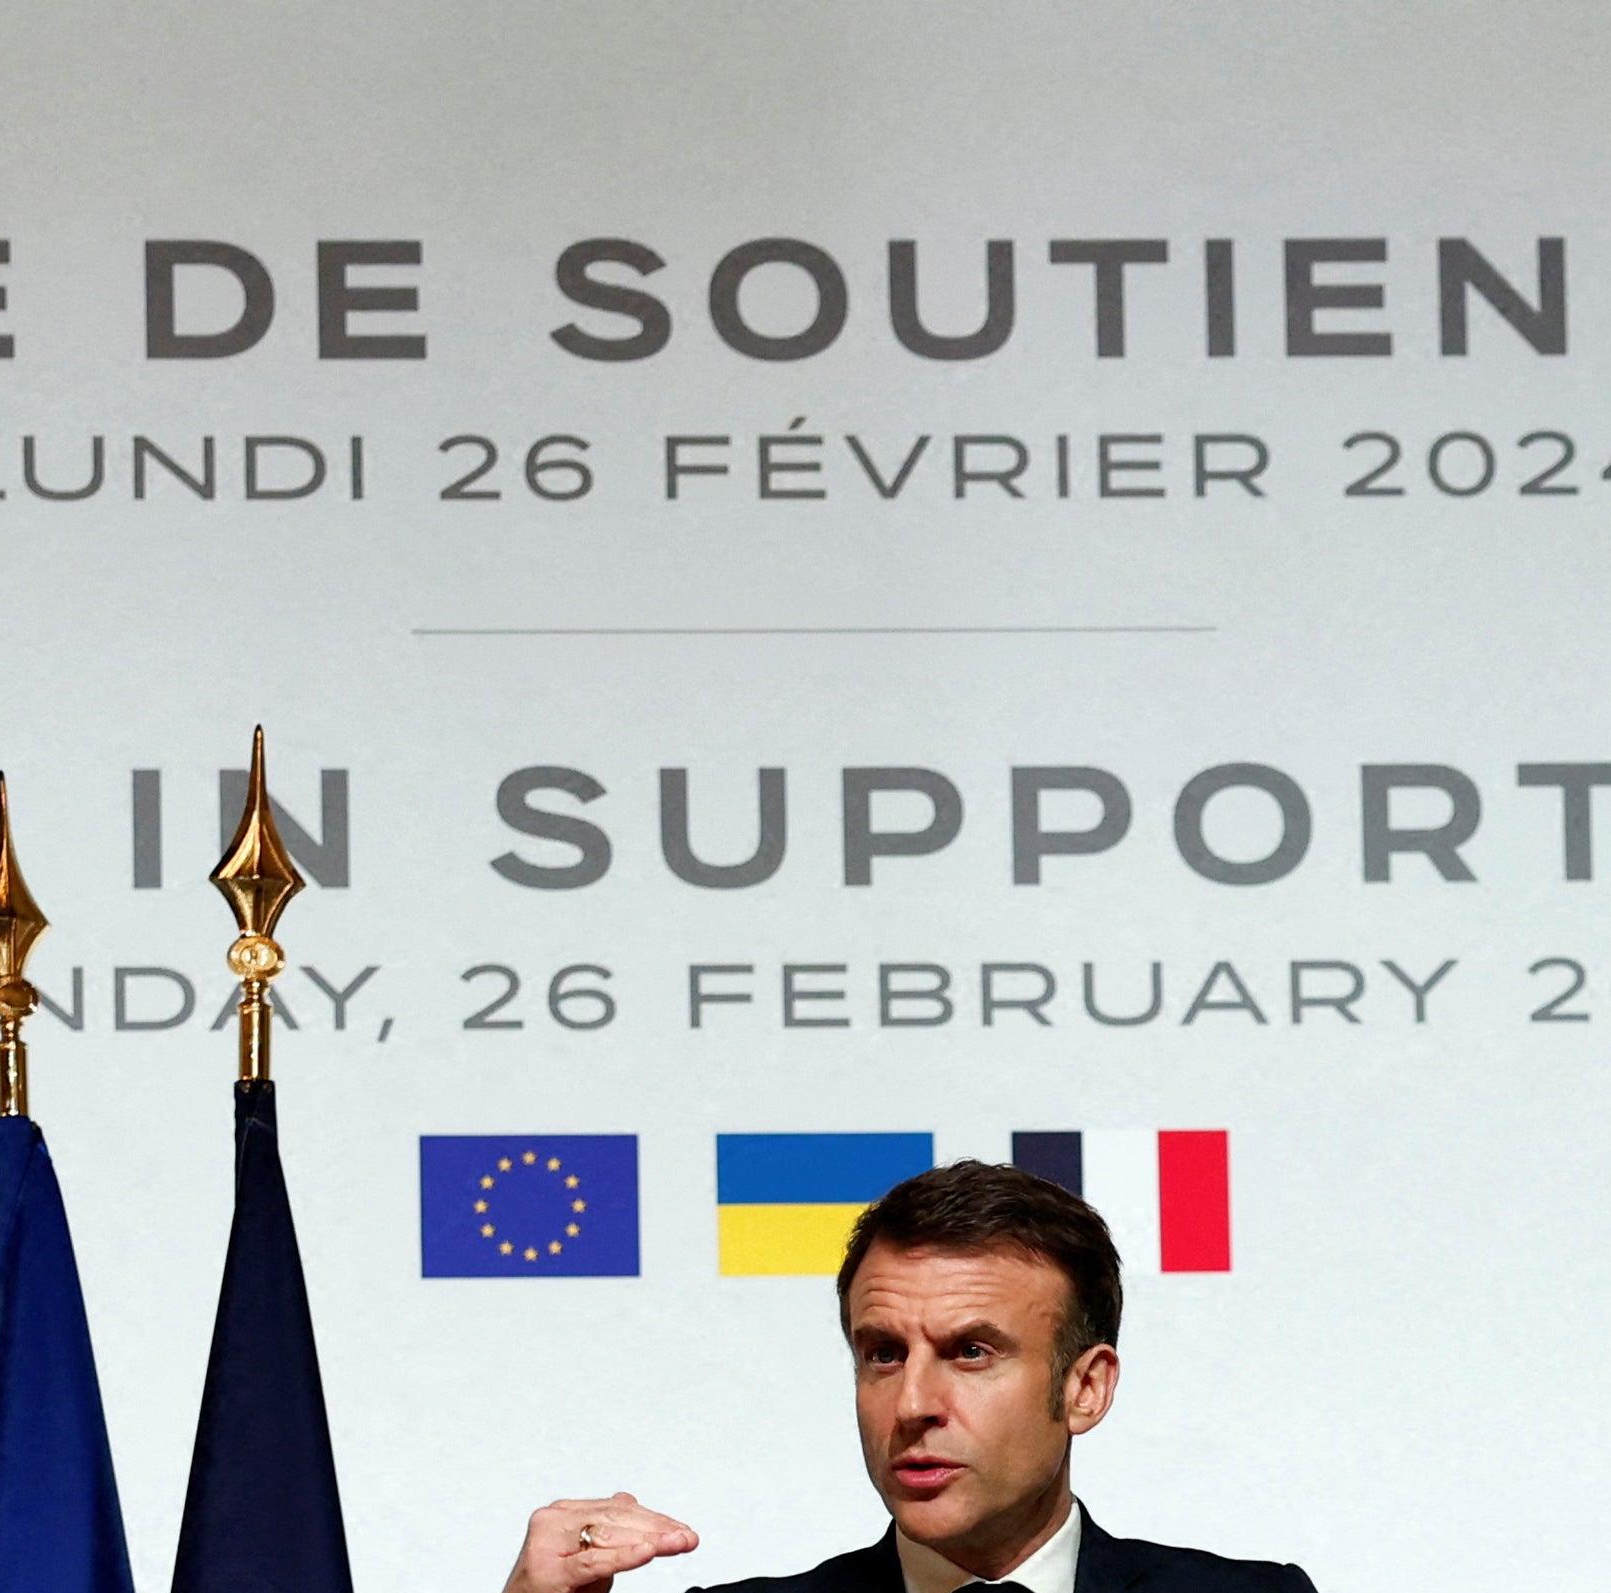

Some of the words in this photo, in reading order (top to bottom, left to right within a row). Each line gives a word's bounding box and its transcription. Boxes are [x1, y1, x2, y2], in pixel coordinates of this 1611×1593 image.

[144, 239, 427, 360] DE
[549, 237, 1567, 362] SOUTIEN
[438, 433, 594, 502] 26
[664, 416, 1270, 501] FÉVRIER
[132, 768, 350, 890] IN
[461, 964, 616, 1030] 26
[689, 960, 1456, 1029] FEBRUARY
